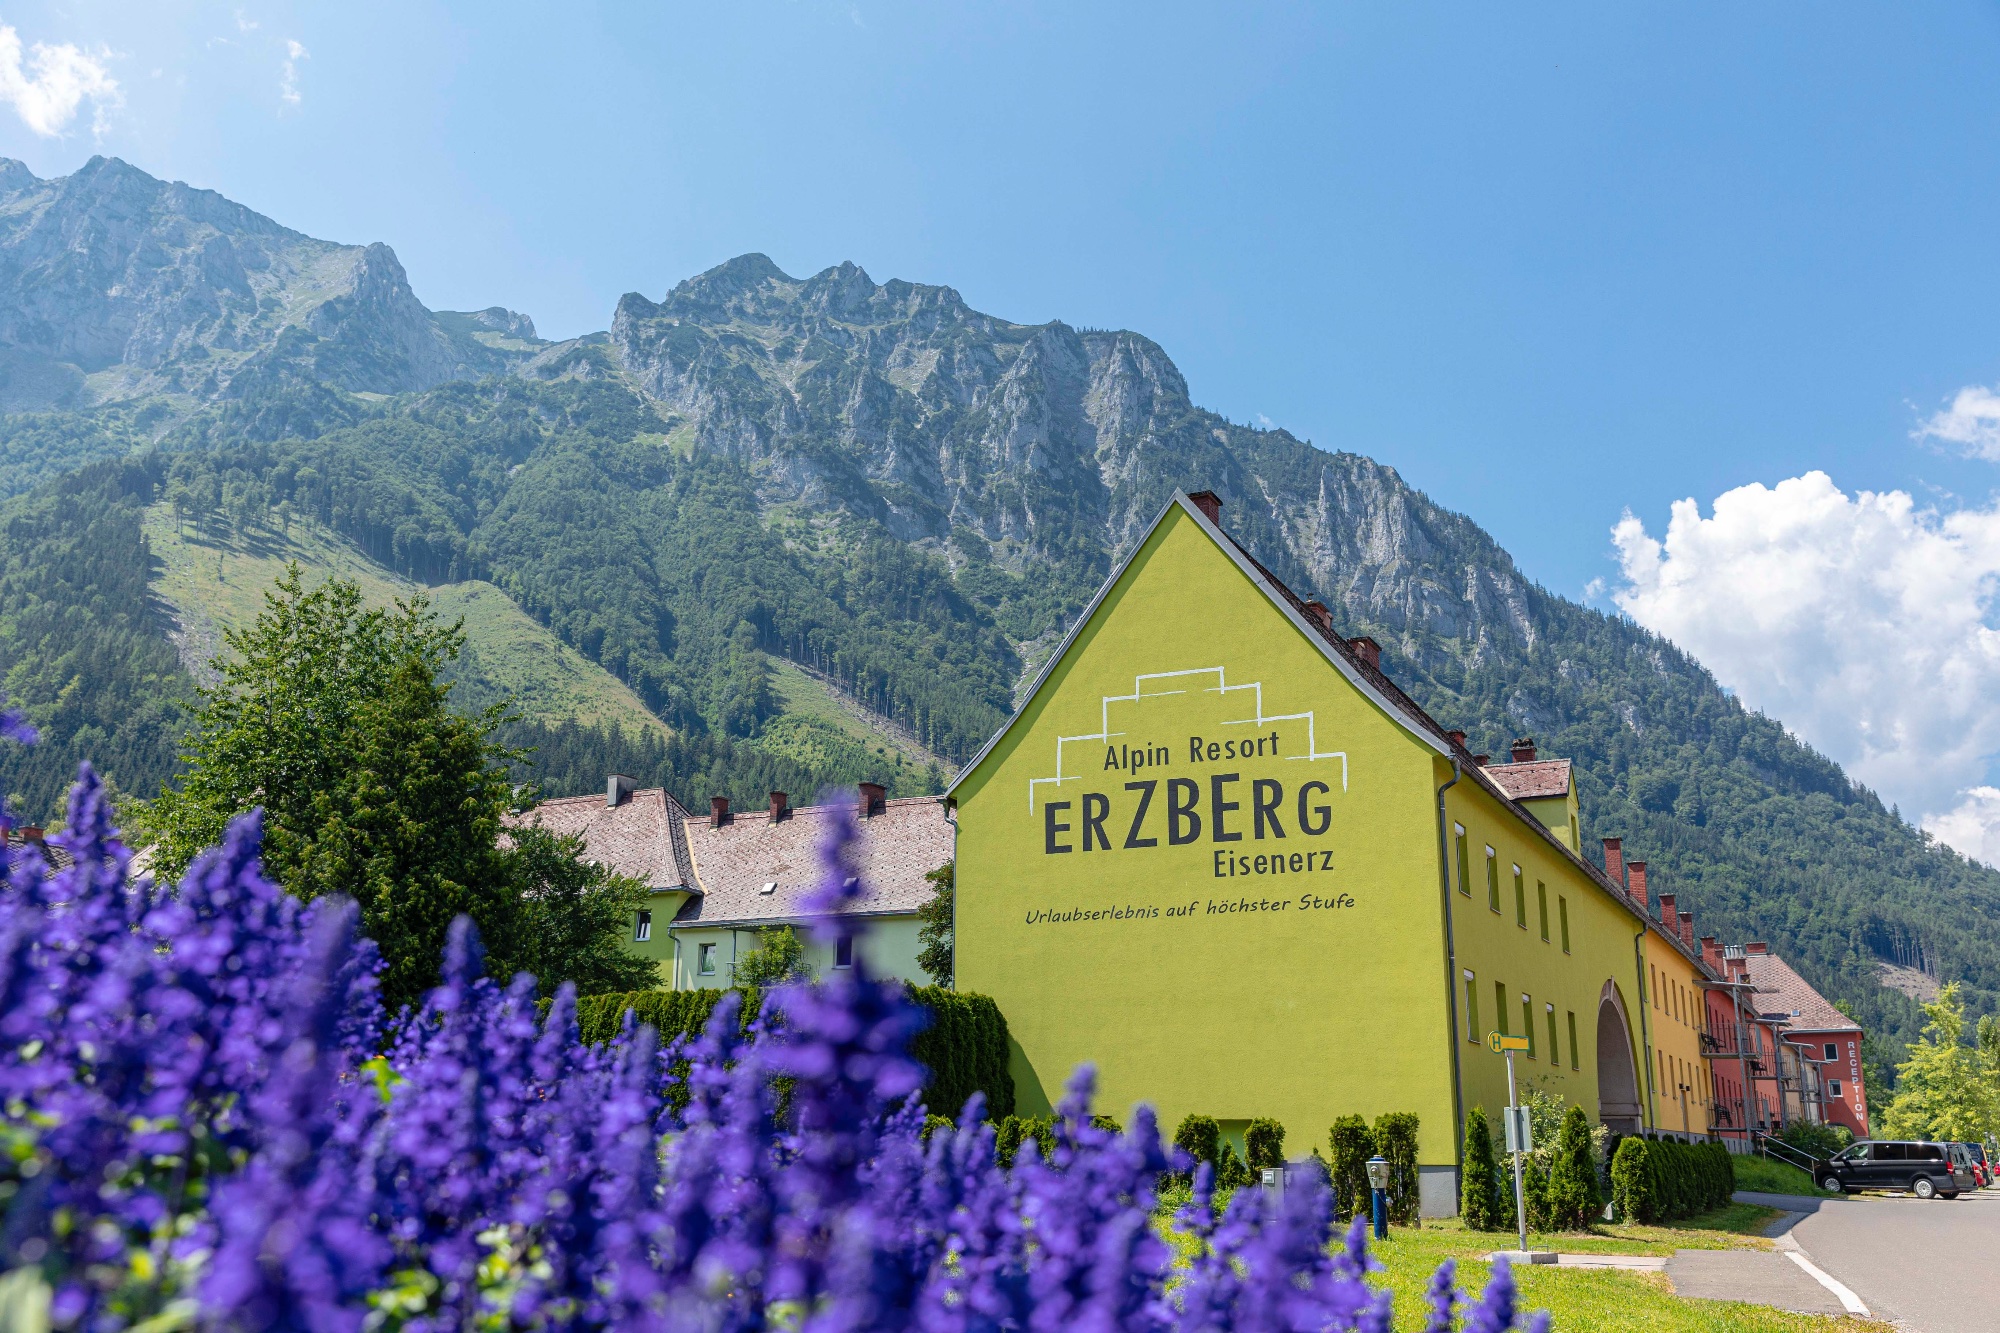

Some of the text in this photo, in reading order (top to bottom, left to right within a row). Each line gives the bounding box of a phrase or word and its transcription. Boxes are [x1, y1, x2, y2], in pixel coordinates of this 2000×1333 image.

[1103, 732, 1279, 775] Alpin Resort
[1044, 773, 1332, 854] ERZBERG
[1213, 850, 1334, 878] Eisenerz
[1025, 893, 1355, 925] Urlaubserlebnis auf höchster Stufe
[1492, 1035, 1501, 1049] H
[1847, 1041, 1864, 1121] RECEPTION
